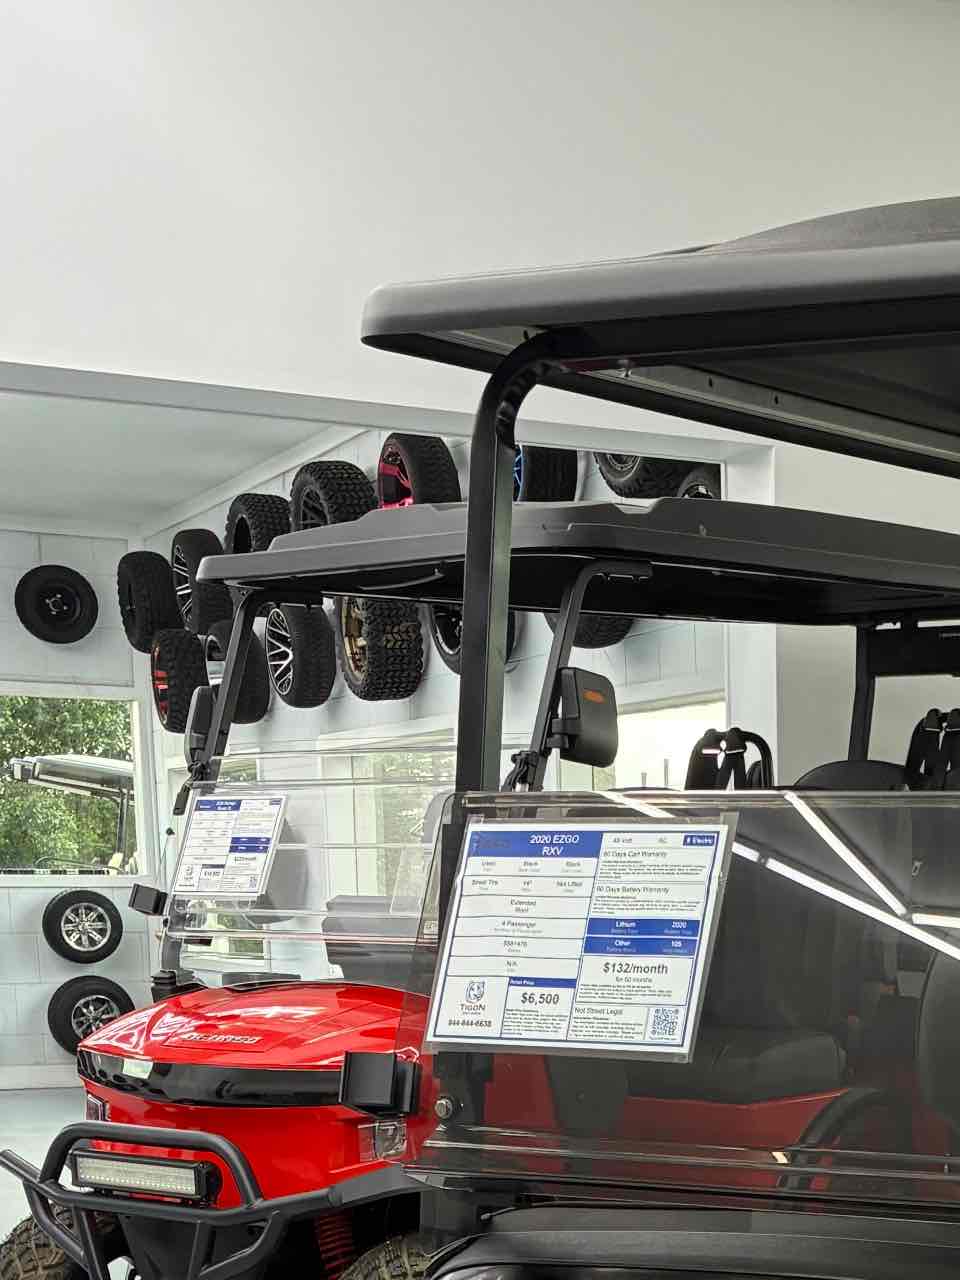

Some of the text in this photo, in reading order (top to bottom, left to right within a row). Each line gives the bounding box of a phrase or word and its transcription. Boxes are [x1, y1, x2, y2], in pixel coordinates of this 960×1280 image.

[529, 834, 580, 845] 2020 EZGO
[542, 845, 564, 856] RXV
[602, 962, 668, 975] $132/month
[520, 991, 560, 1006] $6,500
